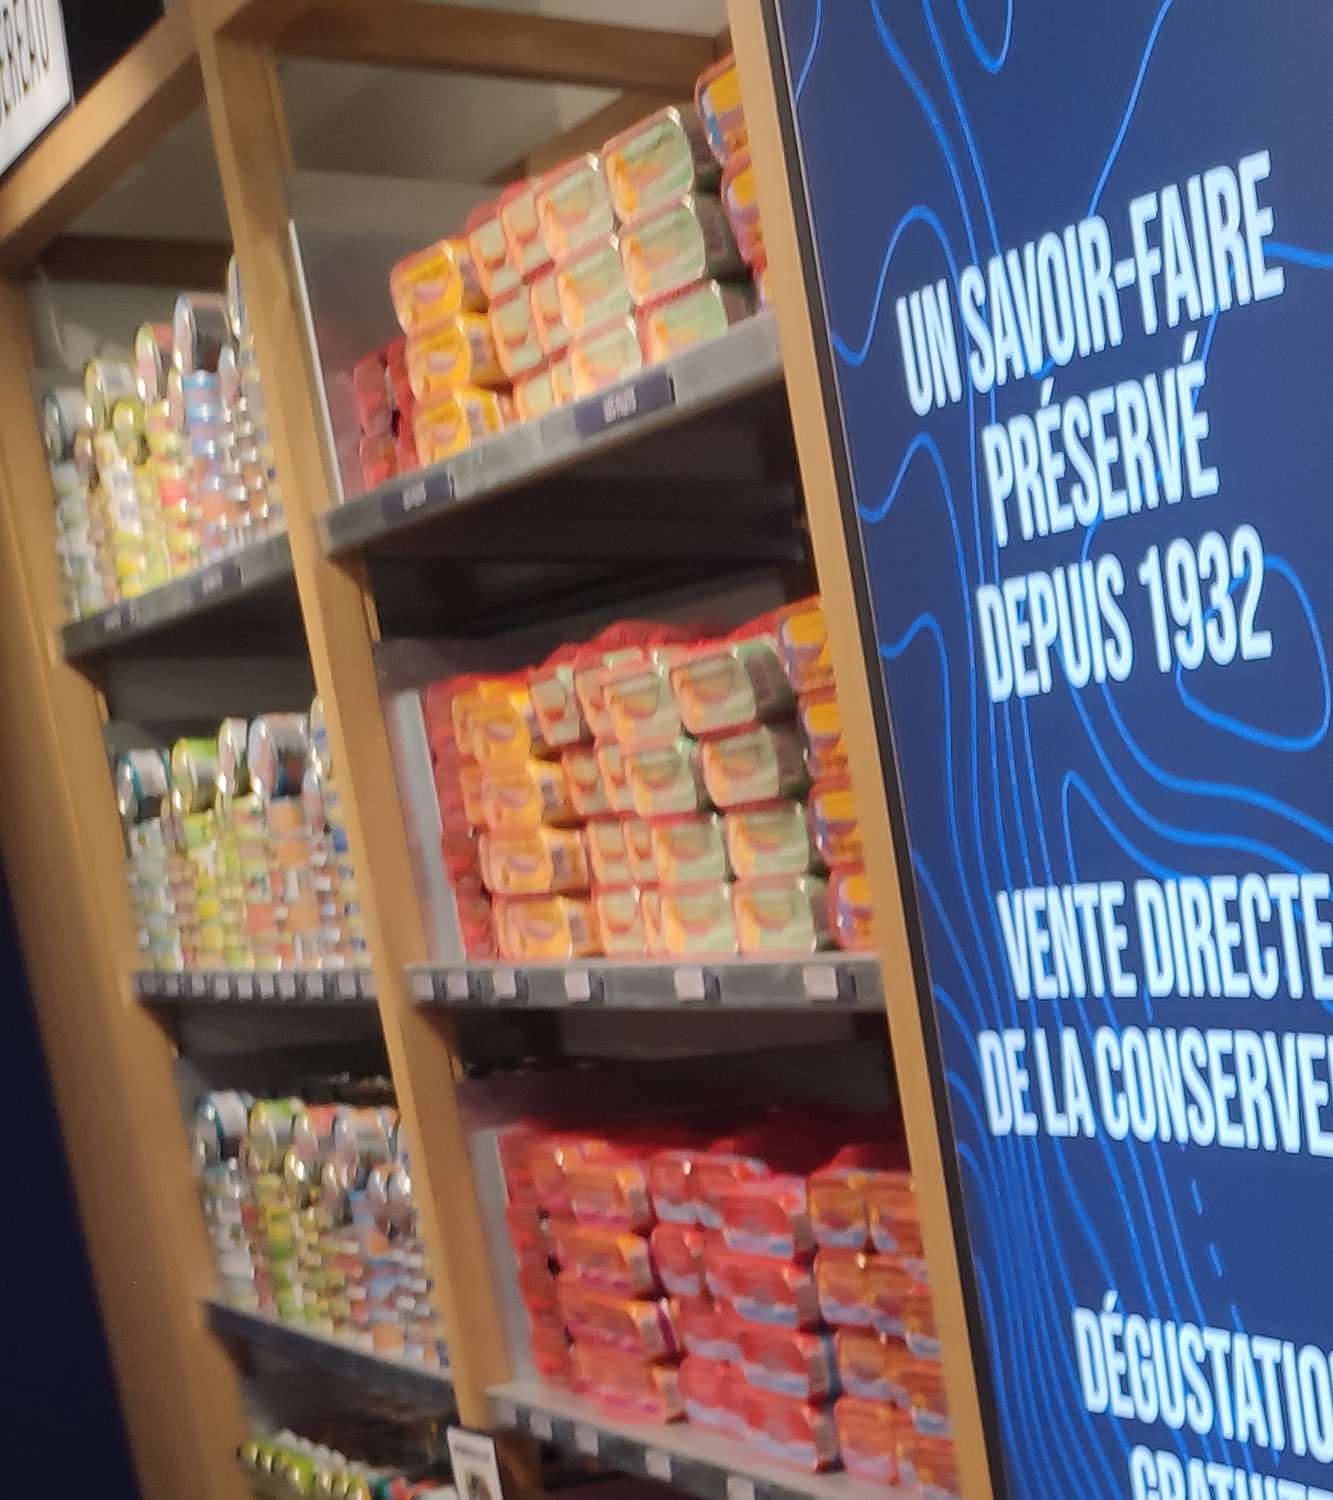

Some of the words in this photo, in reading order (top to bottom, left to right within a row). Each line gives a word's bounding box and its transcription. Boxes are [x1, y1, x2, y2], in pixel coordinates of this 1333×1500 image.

[894, 278, 961, 416] UN
[961, 149, 1286, 394] SAVOIR-FAIRE
[982, 332, 1220, 548] PRÉSERVÉ
[976, 552, 1135, 703] DEPUIS
[1138, 524, 1274, 675] 1932
[996, 879, 1137, 1000] VENTE
[977, 1027, 1039, 1137] DE
[1036, 1026, 1095, 1138] LA
